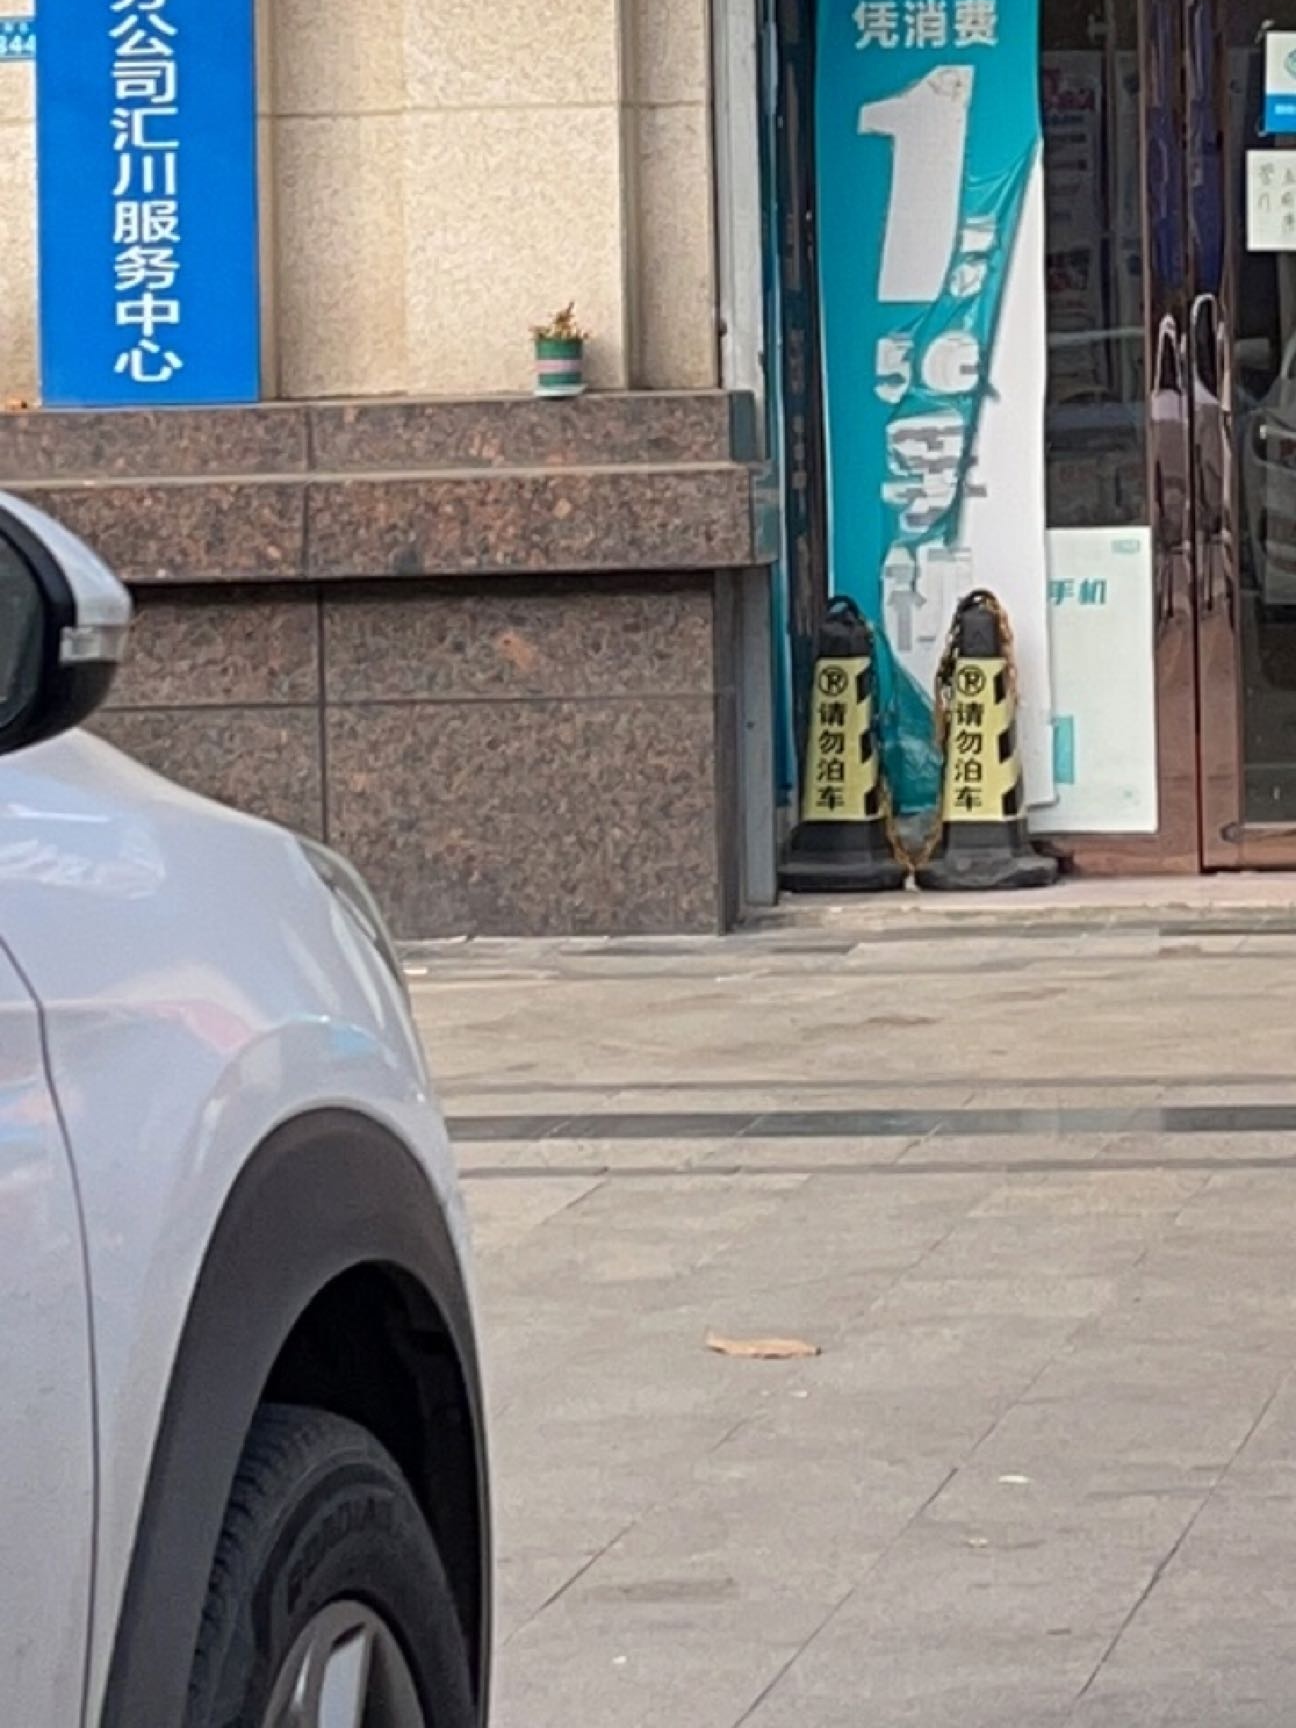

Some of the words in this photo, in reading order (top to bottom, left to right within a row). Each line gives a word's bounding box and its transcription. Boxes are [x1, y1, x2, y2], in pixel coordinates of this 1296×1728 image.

[816, 701, 848, 812] 请勿泊车
[955, 701, 986, 812] 请勿泊车
